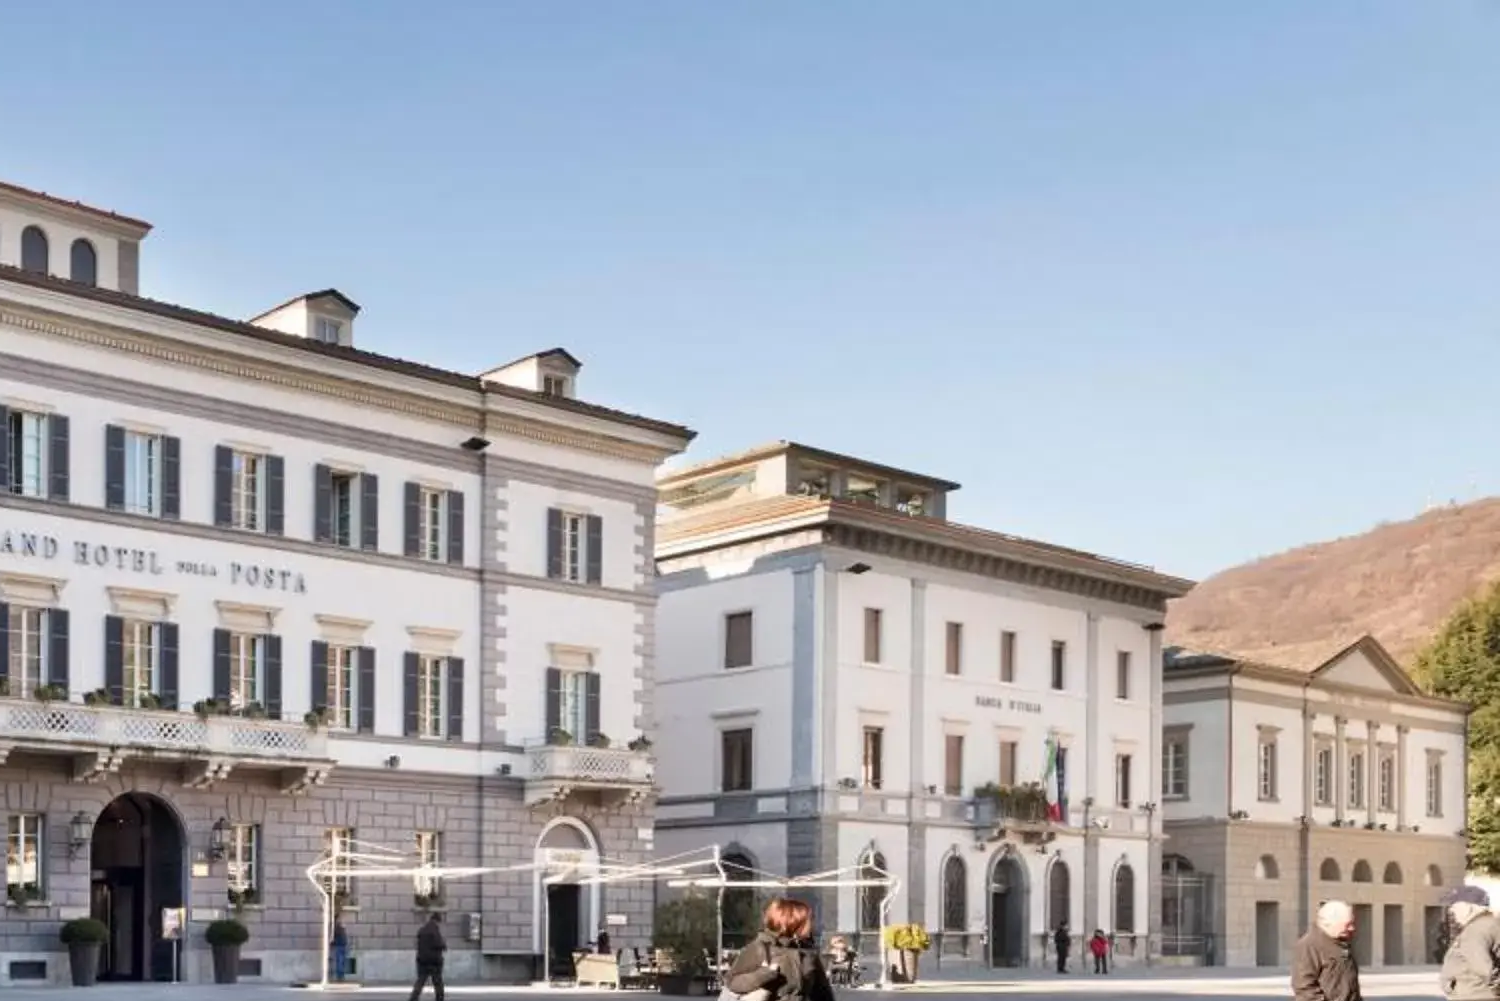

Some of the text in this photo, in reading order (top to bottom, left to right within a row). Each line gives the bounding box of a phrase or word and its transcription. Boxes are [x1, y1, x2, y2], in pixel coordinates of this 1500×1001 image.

[73, 541, 163, 576] HOTEL
[230, 561, 309, 595] POSTA
[975, 695, 1042, 714] BANCA D'ITALIA
